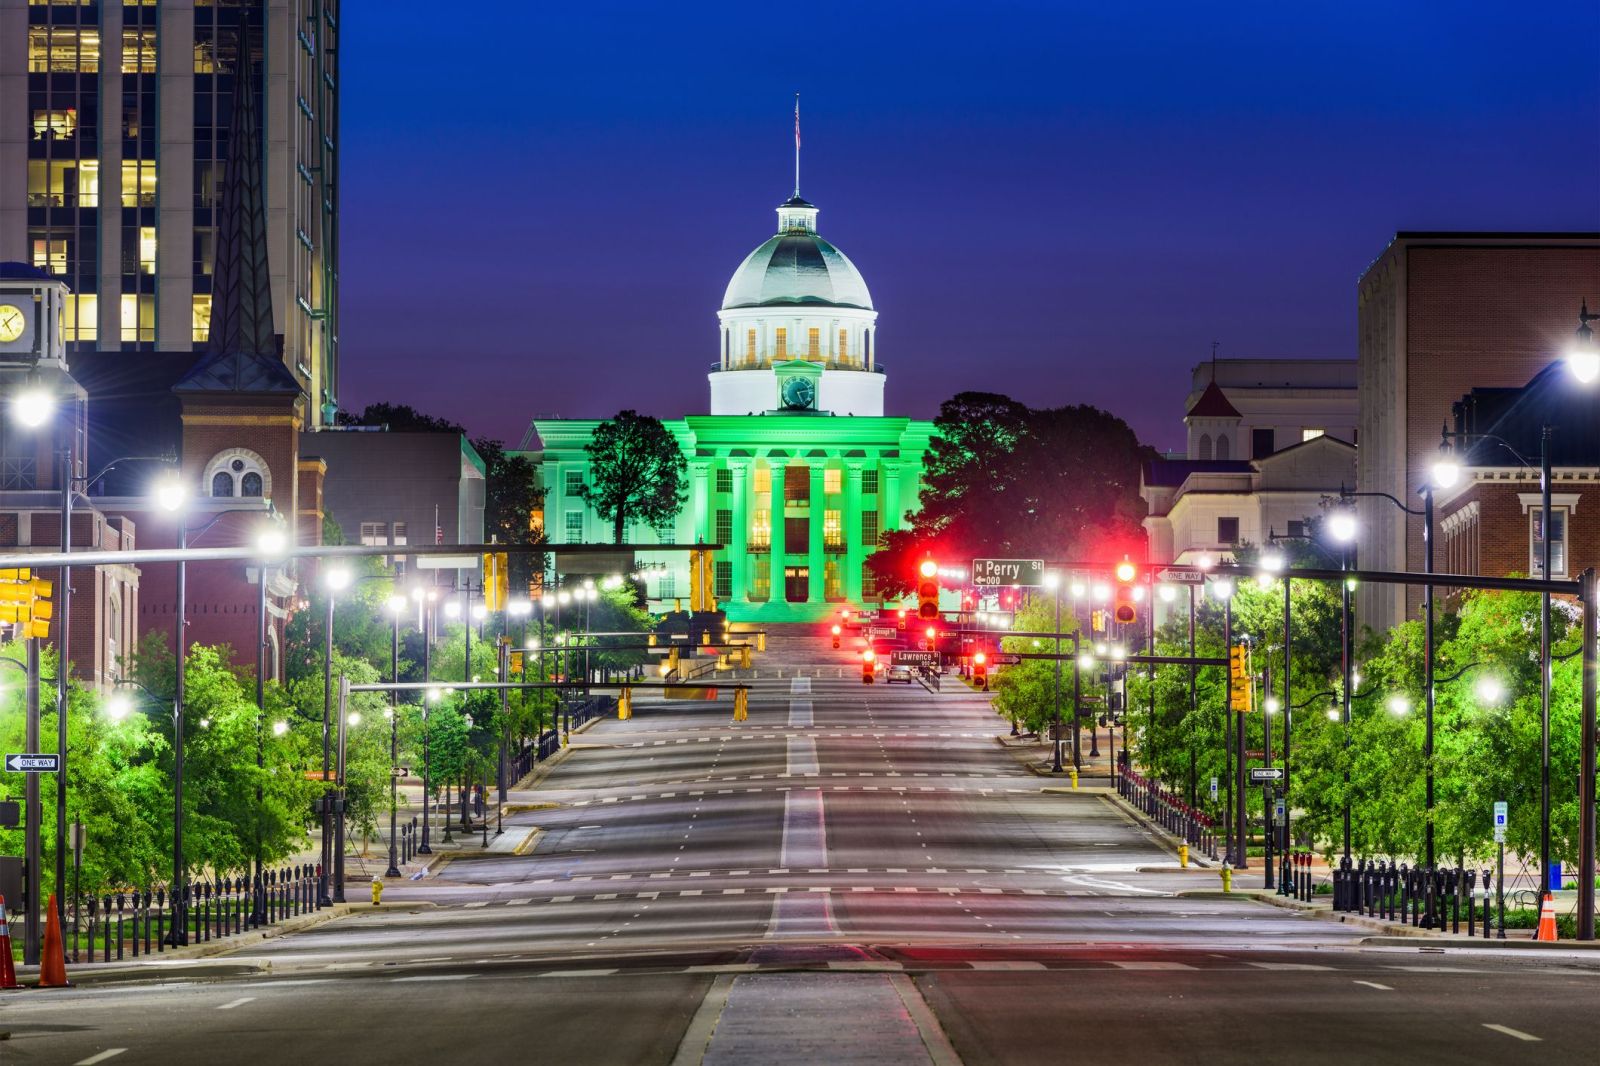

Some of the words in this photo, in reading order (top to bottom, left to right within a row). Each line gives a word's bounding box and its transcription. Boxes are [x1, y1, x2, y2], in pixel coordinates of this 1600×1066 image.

[976, 563, 982, 572] N
[986, 561, 1019, 579] Perry
[1031, 561, 1041, 570] St
[898, 651, 931, 660] Lawrence
